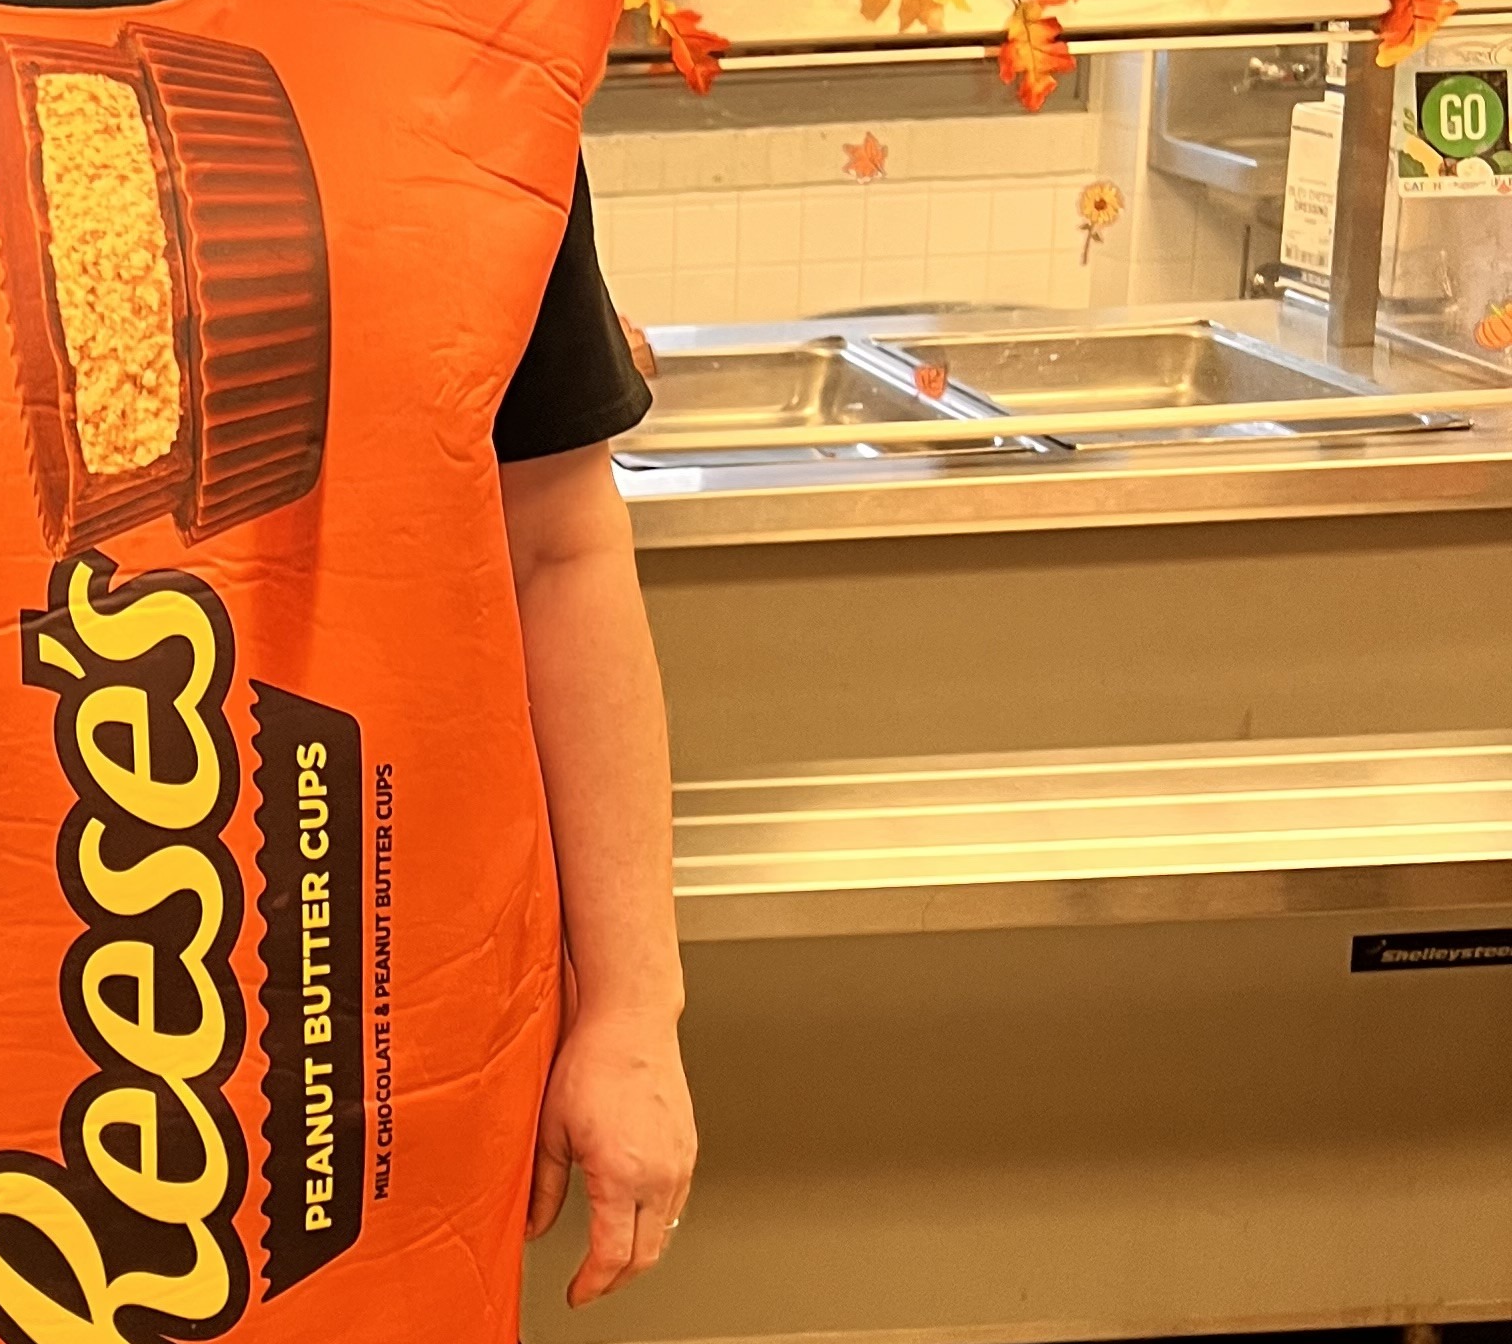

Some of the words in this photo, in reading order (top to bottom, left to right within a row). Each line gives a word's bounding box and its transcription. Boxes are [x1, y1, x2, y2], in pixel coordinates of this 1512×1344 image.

[1439, 93, 1486, 140] GO
[296, 742, 329, 860] CUPS
[375, 763, 393, 820] CUPS
[375, 824, 393, 908] BUTTER
[301, 871, 332, 1045] BUTTER
[374, 913, 391, 999] PEANUT
[1381, 945, 1512, 963] Shelleystee
[374, 1003, 391, 1016] &
[374, 1022, 393, 1147] CHOCOLATE
[304, 1057, 334, 1231] PEANUT
[374, 1151, 392, 1200] MILK
